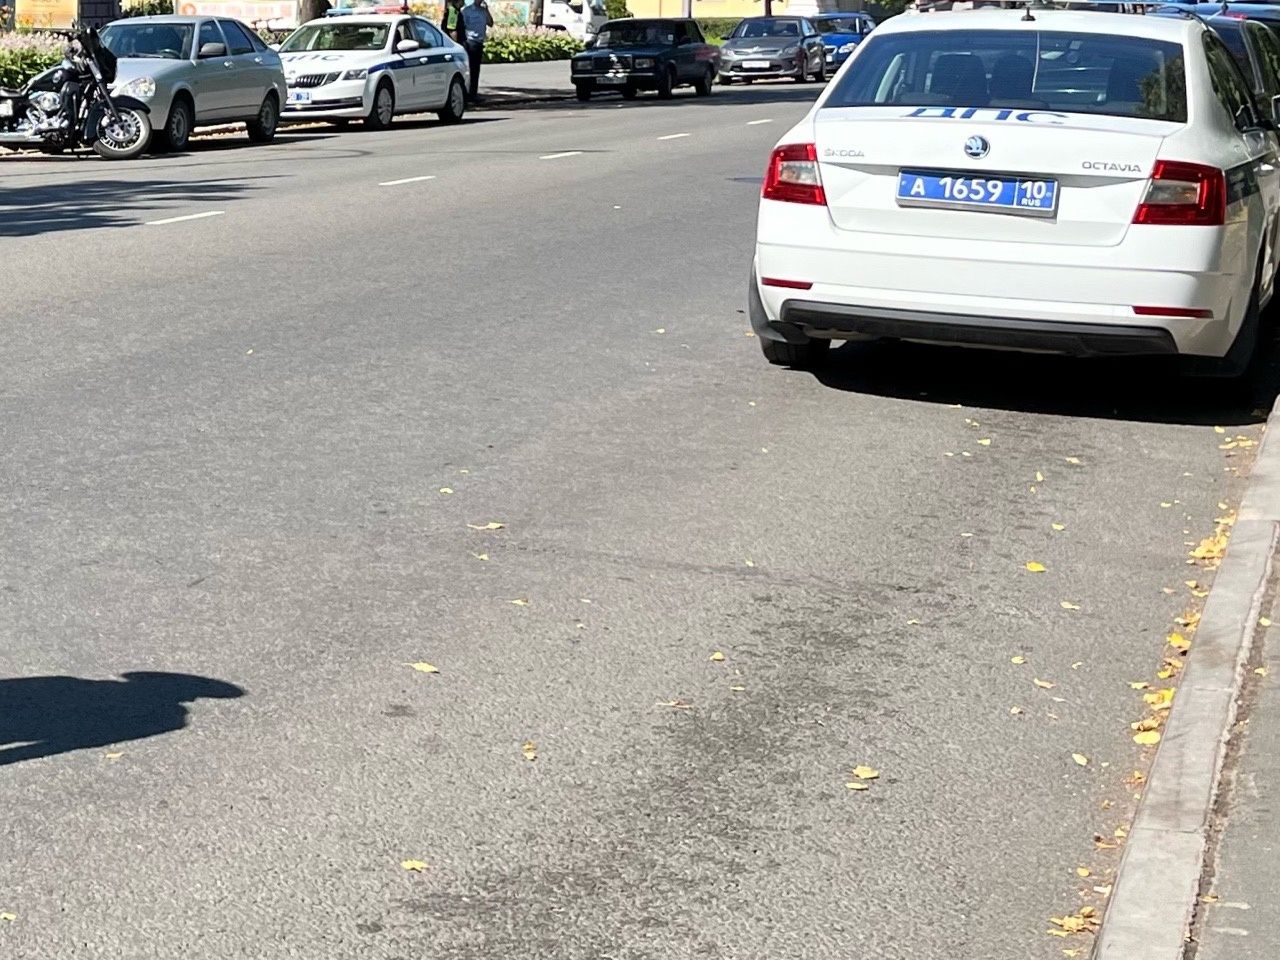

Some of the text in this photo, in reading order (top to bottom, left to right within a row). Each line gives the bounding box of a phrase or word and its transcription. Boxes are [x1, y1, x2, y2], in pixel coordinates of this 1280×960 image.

[1082, 161, 1142, 172] OCTAVIA
[939, 177, 1003, 202] 1659
[1020, 181, 1047, 199] 10
[1021, 198, 1041, 207] RUS
